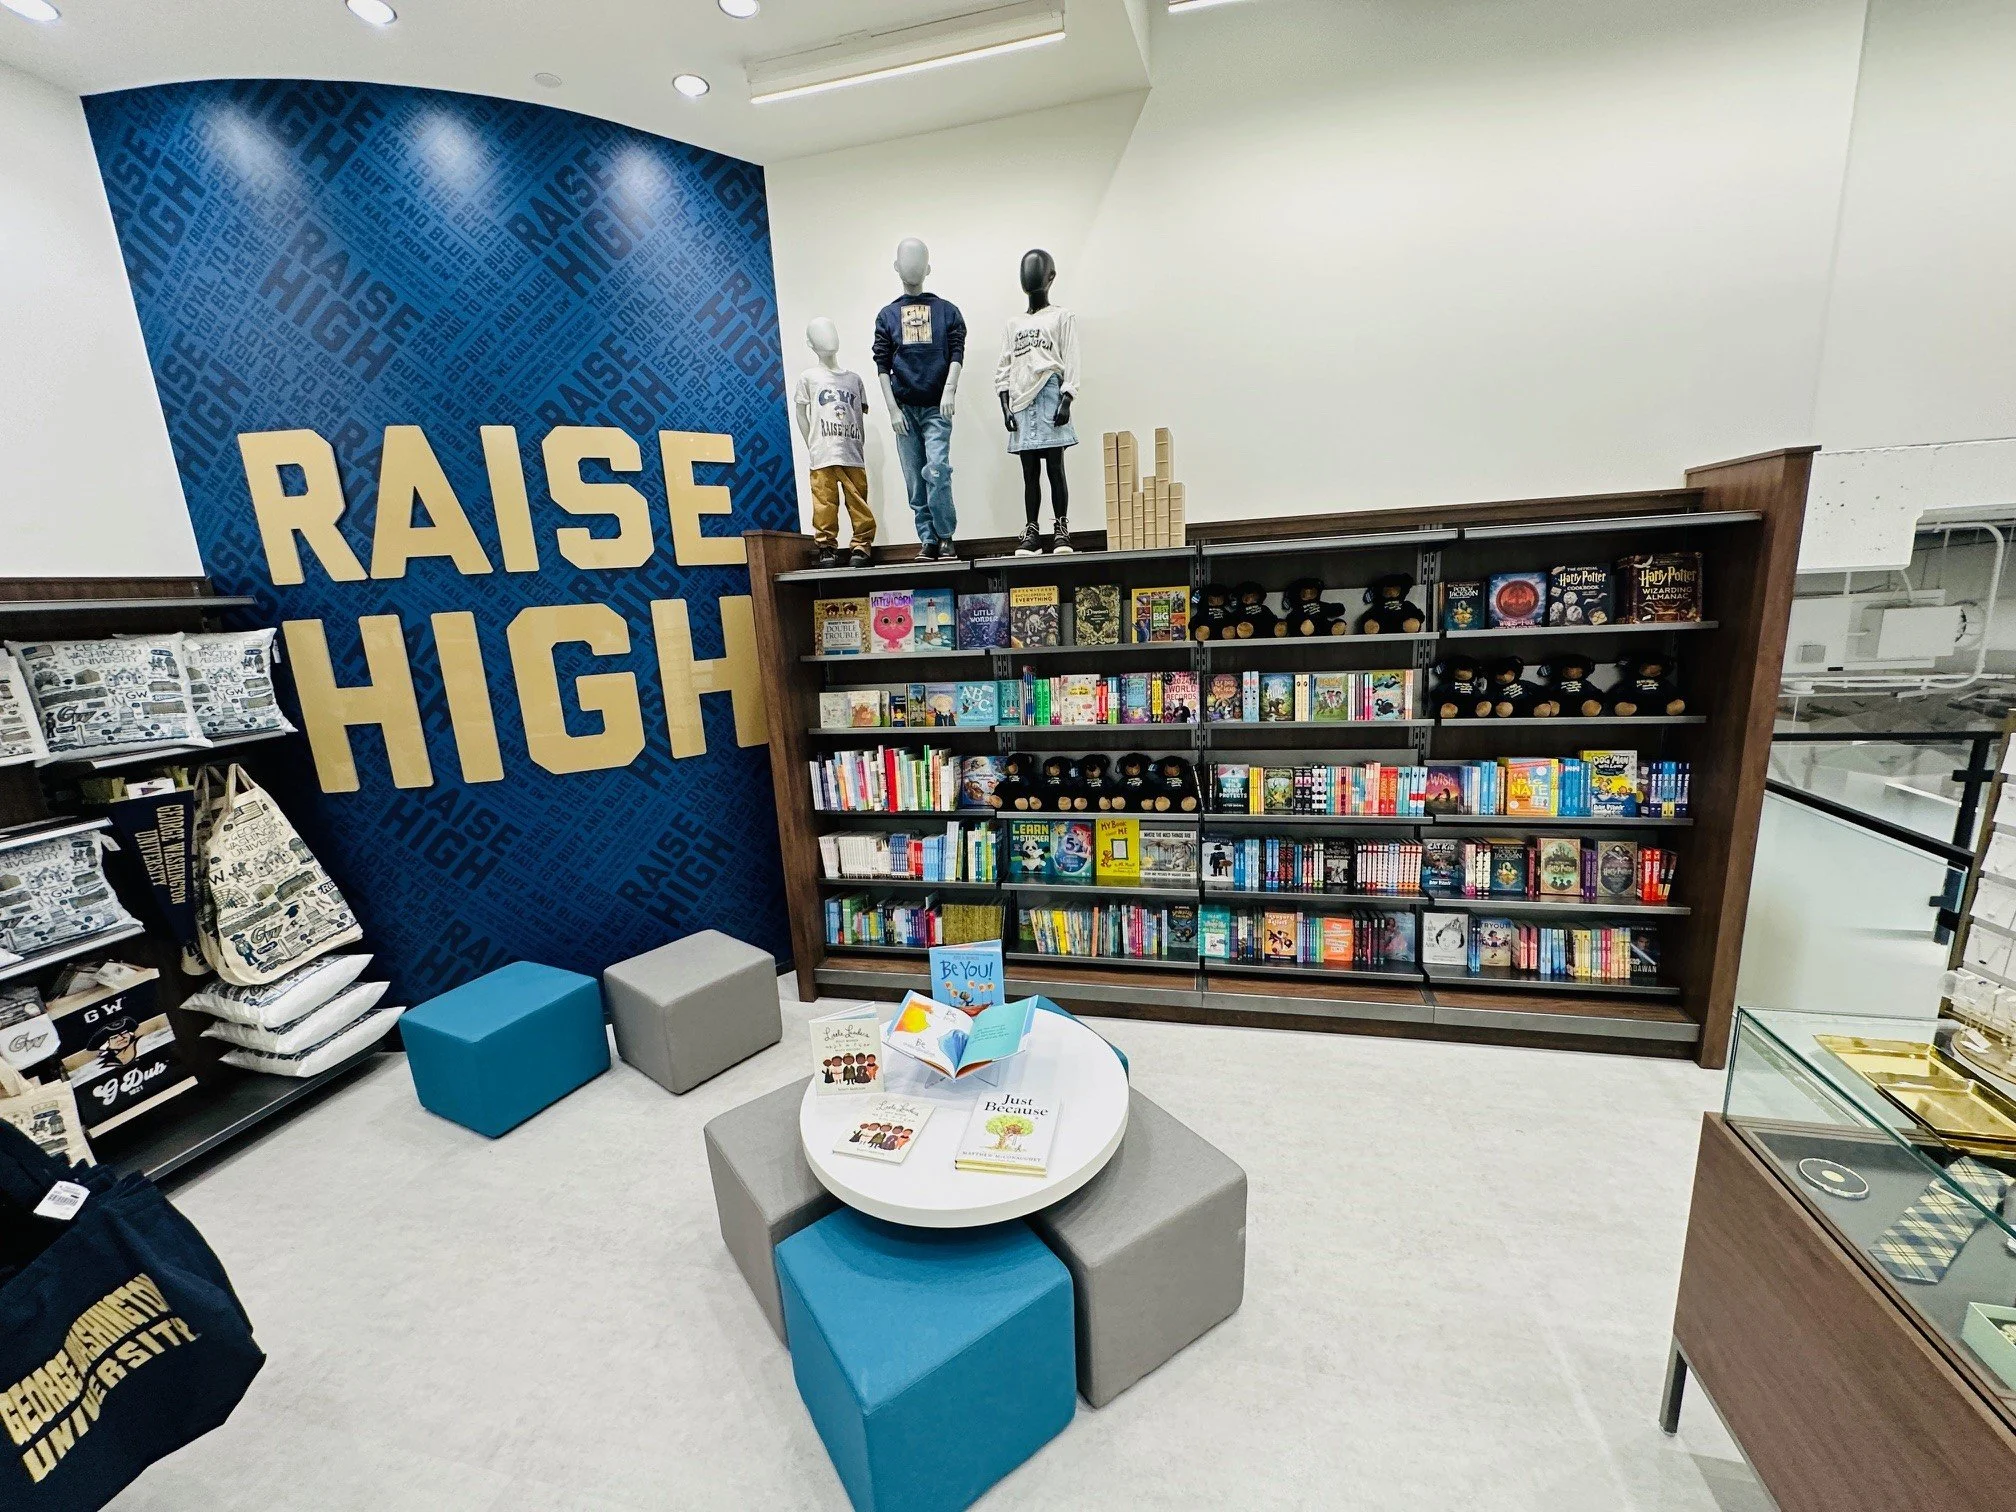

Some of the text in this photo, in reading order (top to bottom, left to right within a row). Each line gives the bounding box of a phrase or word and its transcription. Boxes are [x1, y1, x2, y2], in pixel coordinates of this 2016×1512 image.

[504, 147, 614, 257] RAISE
[429, 226, 478, 271] BLUE!
[542, 196, 657, 299] HIGH
[287, 218, 425, 346] RAISE
[649, 271, 673, 297] TO
[258, 254, 399, 385] HIGH
[716, 381, 737, 408] TO
[820, 418, 843, 438] RAISE
[237, 424, 747, 586] RAISE
[1558, 571, 1607, 587] Harry Potter
[1639, 566, 1698, 588] Harry Potter
[1448, 590, 1479, 600] JACKSON
[1642, 586, 1693, 595] WIZARDING
[1645, 593, 1689, 601] ALMANAC
[969, 615, 999, 623] WONDER
[973, 609, 996, 617] LITTLE
[1152, 612, 1170, 621] BIG
[824, 632, 860, 641] TROUBLE
[826, 625, 857, 634] DOUBLE
[125, 690, 149, 700] GW
[226, 686, 244, 697] GW
[282, 594, 769, 793] HIGH
[1168, 685, 1197, 694] WORLD
[1593, 755, 1610, 765] DOG
[1511, 783, 1549, 796] NATE
[1012, 824, 1049, 835] LEARN
[377, 796, 502, 892] HIGH
[1020, 834, 1050, 843] STICKER
[156, 804, 187, 905] GEORGE WASHINGTON
[1427, 843, 1441, 851] CAT
[134, 828, 168, 887] UNIVERSITY
[616, 813, 705, 910] RAISE
[645, 827, 738, 930] HIGH
[51, 886, 74, 898] GW
[1002, 1094, 1034, 1106] Just
[984, 1101, 1049, 1116] Because
[0, 1349, 84, 1447] GEORGE
[22, 1317, 197, 1484] UNIVERSITY
